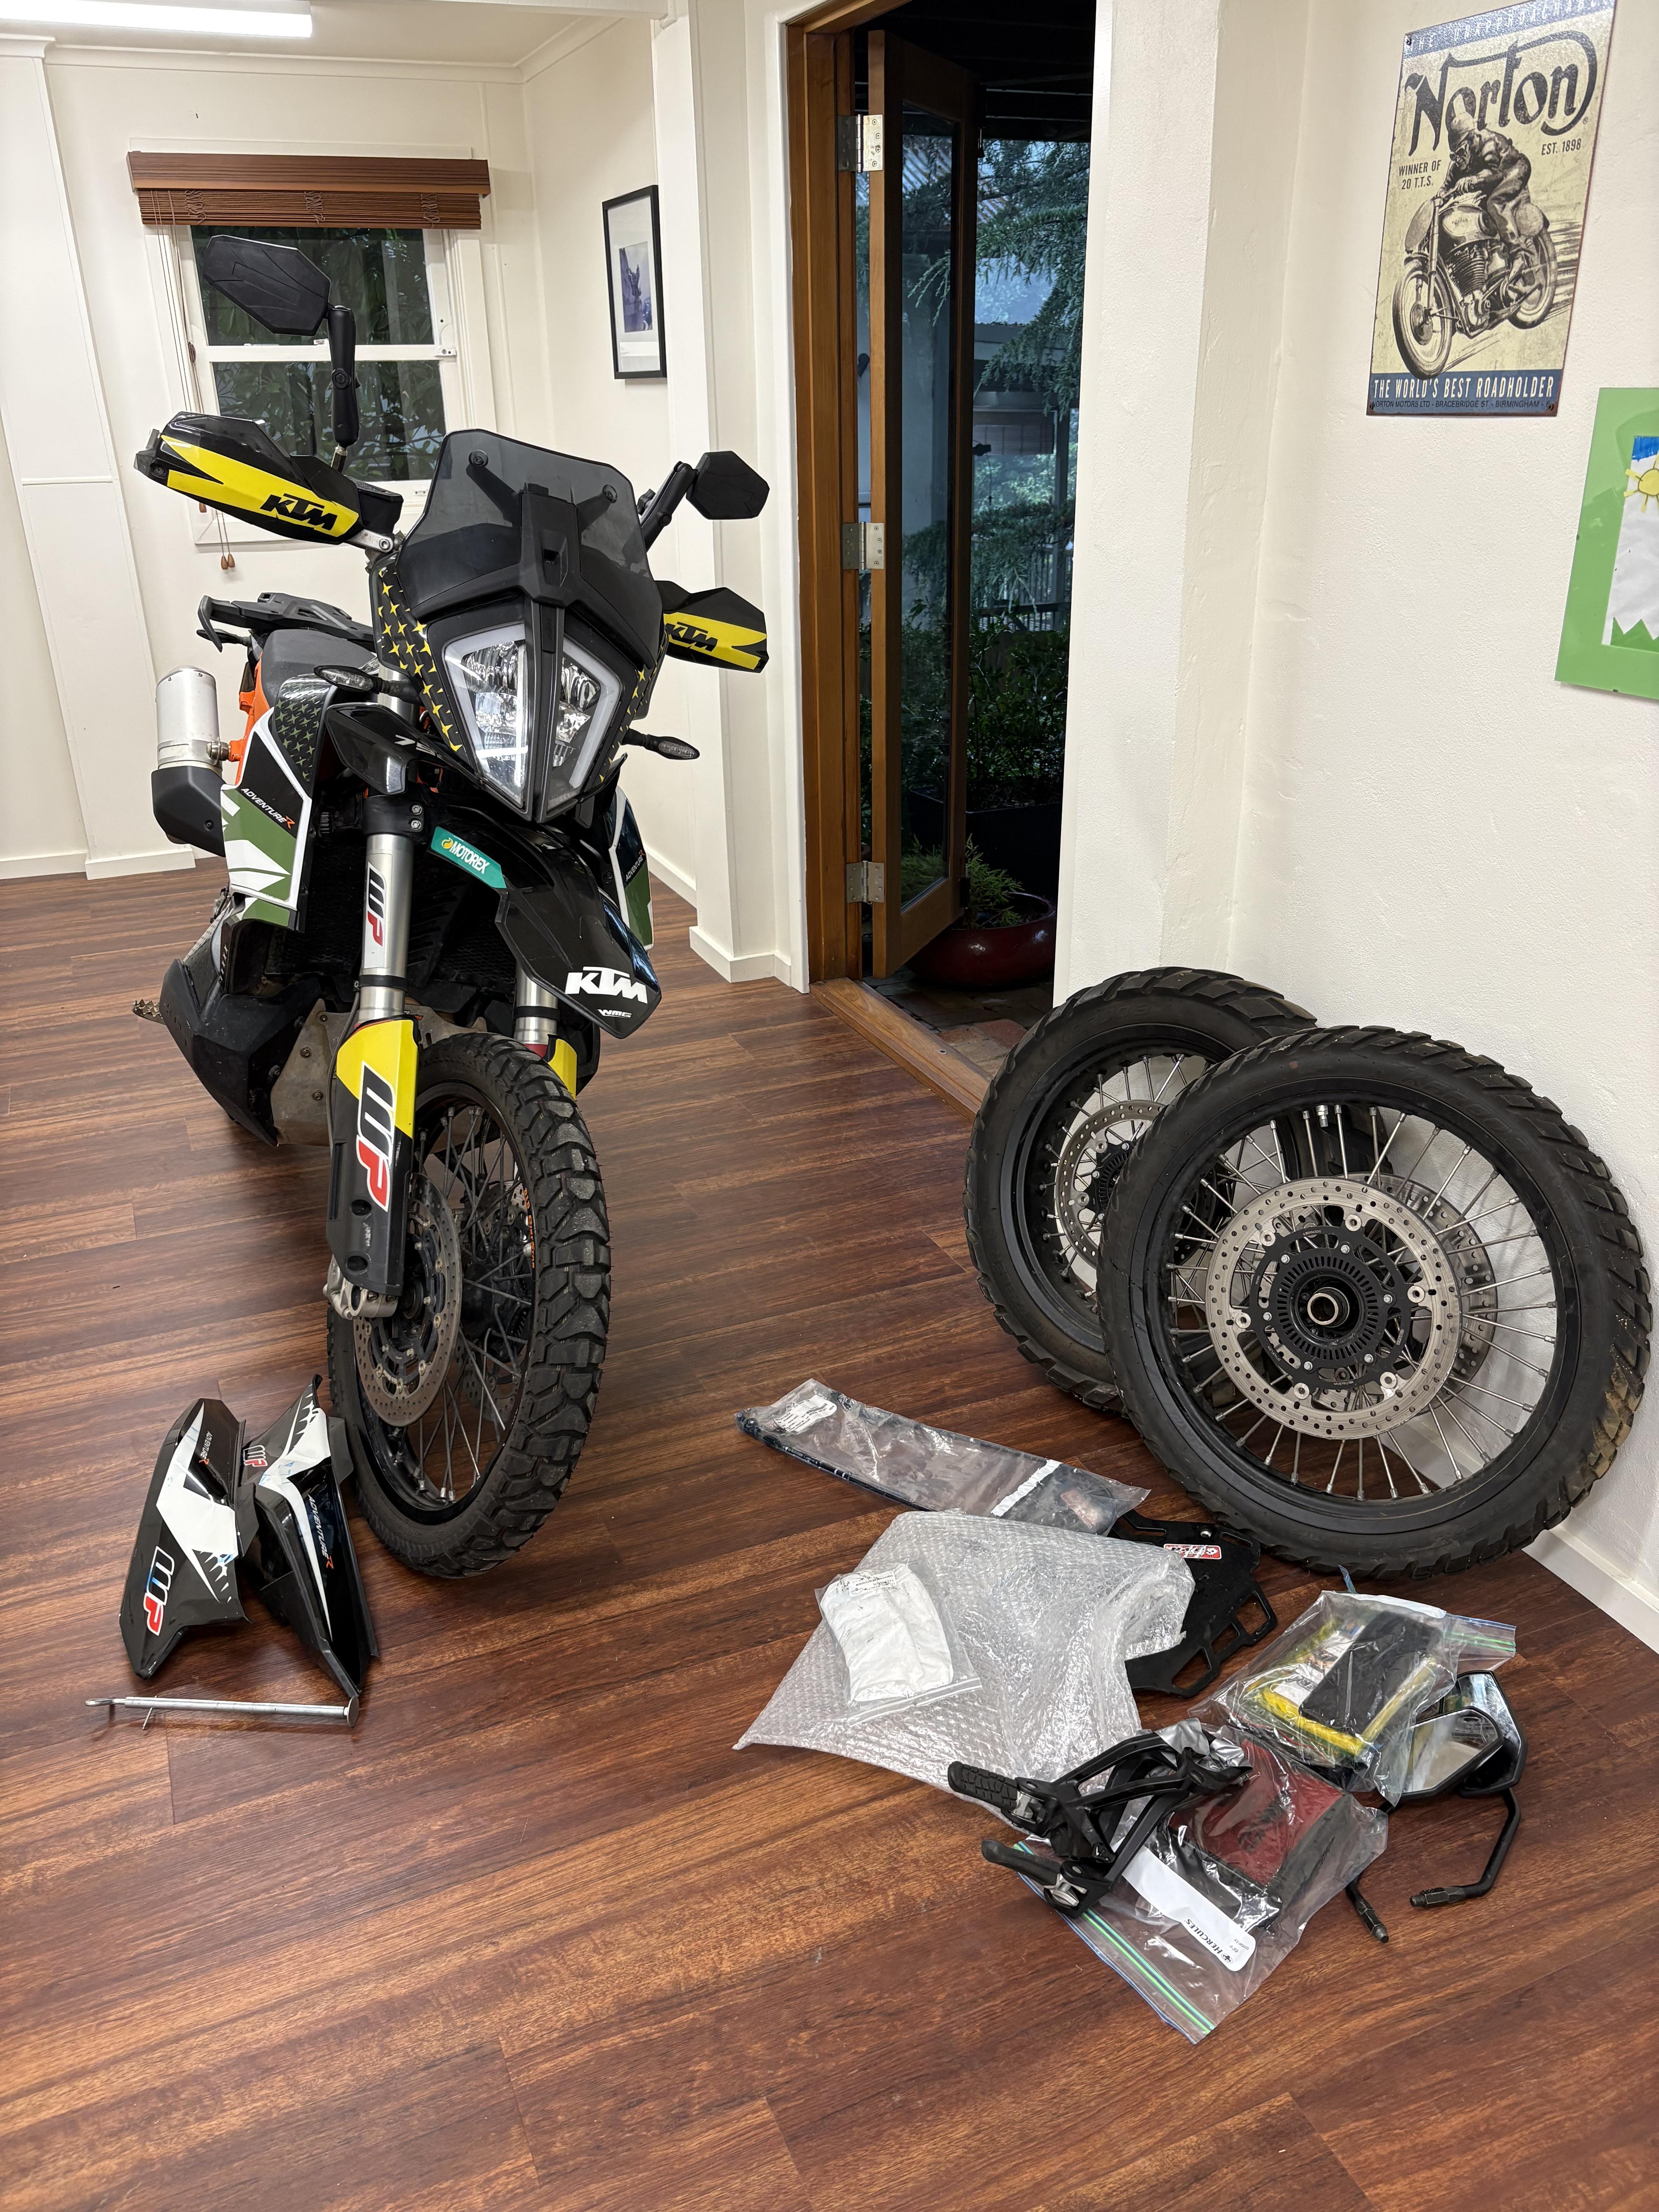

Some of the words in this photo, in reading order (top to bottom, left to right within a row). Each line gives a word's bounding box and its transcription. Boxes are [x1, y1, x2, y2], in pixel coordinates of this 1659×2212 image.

[1408, 35, 1434, 51] HE
[1405, 30, 1597, 156] Norton
[1541, 143, 1558, 155] EST.
[1561, 138, 1582, 153] 1898
[1398, 162, 1428, 177] WINNER
[1431, 159, 1441, 172] OF
[1401, 179, 1412, 190] 20
[1413, 177, 1434, 189] T.T.S.
[1374, 379, 1391, 398] THE
[1395, 378, 1439, 398] WORLD'S
[1443, 378, 1471, 398] BEST
[1476, 376, 1554, 398] ROADHOLDER
[260, 493, 338, 531] KTM
[665, 621, 718, 652] KTM
[240, 788, 292, 823] ADVENTURE
[449, 840, 490, 874] MOTOREX
[626, 855, 644, 881] ADVENTURE
[565, 966, 648, 1004] KTM
[200, 1431, 213, 1460] ADVENTURE
[307, 1494, 330, 1558] ADVENTURE
[1185, 1918, 1223, 1954] HERCULES
